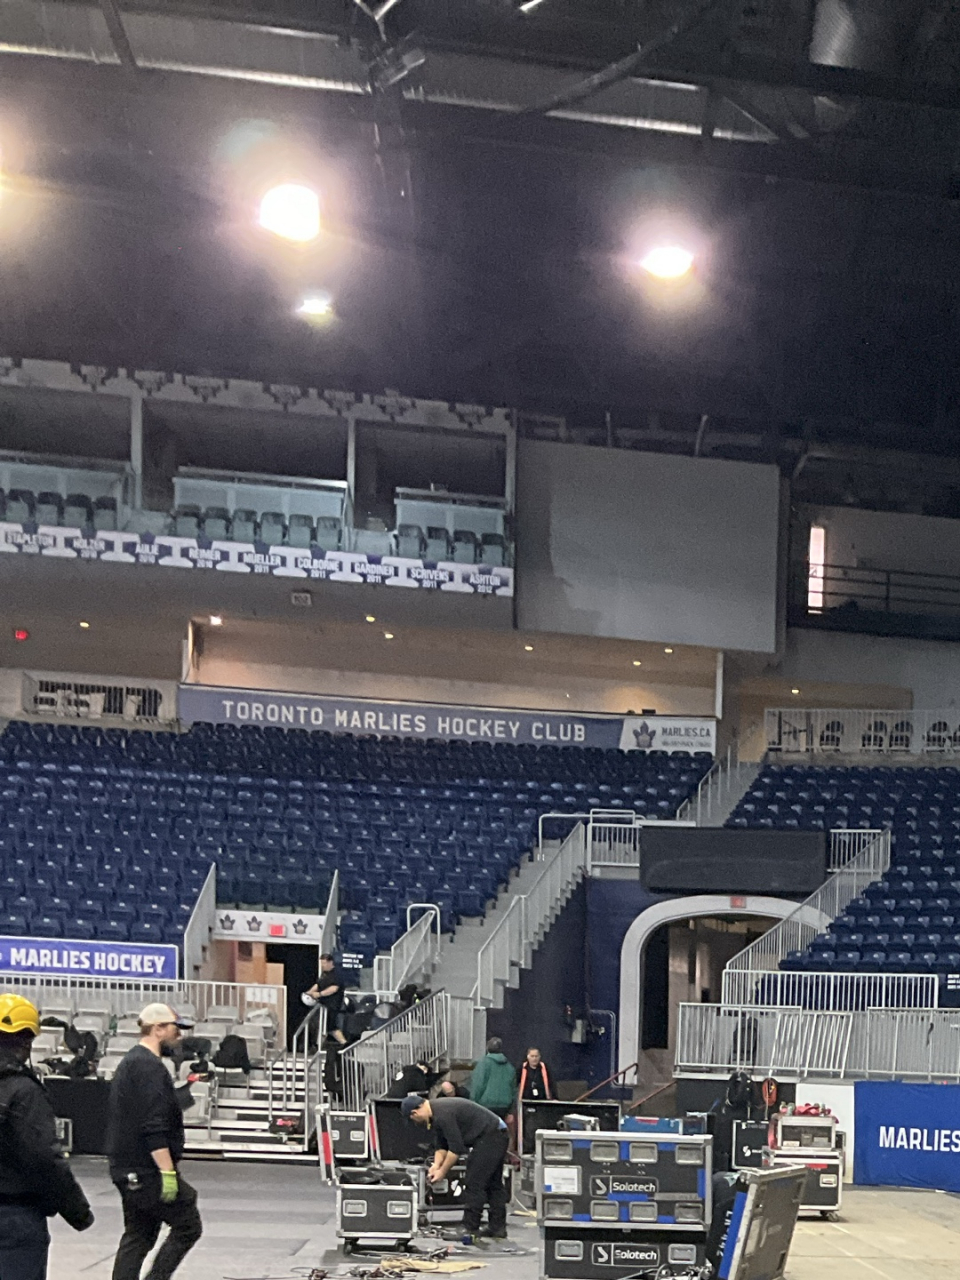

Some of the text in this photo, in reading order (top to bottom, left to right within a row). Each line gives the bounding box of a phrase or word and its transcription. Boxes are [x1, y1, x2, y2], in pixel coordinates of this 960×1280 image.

[189, 547, 221, 561] REIMER
[243, 552, 281, 566] MUELLER
[297, 557, 339, 571] COLBORNE
[355, 562, 395, 577] GARDINER
[411, 568, 450, 582] SCRIVENS
[470, 573, 500, 586] ASHTON
[222, 700, 585, 742] TORONTO MARLIES HOCKEY CLUB
[10, 947, 166, 974] MARLIES HOCKEY
[612, 1182, 656, 1193] Solotech
[615, 1249, 657, 1260] Solotech
